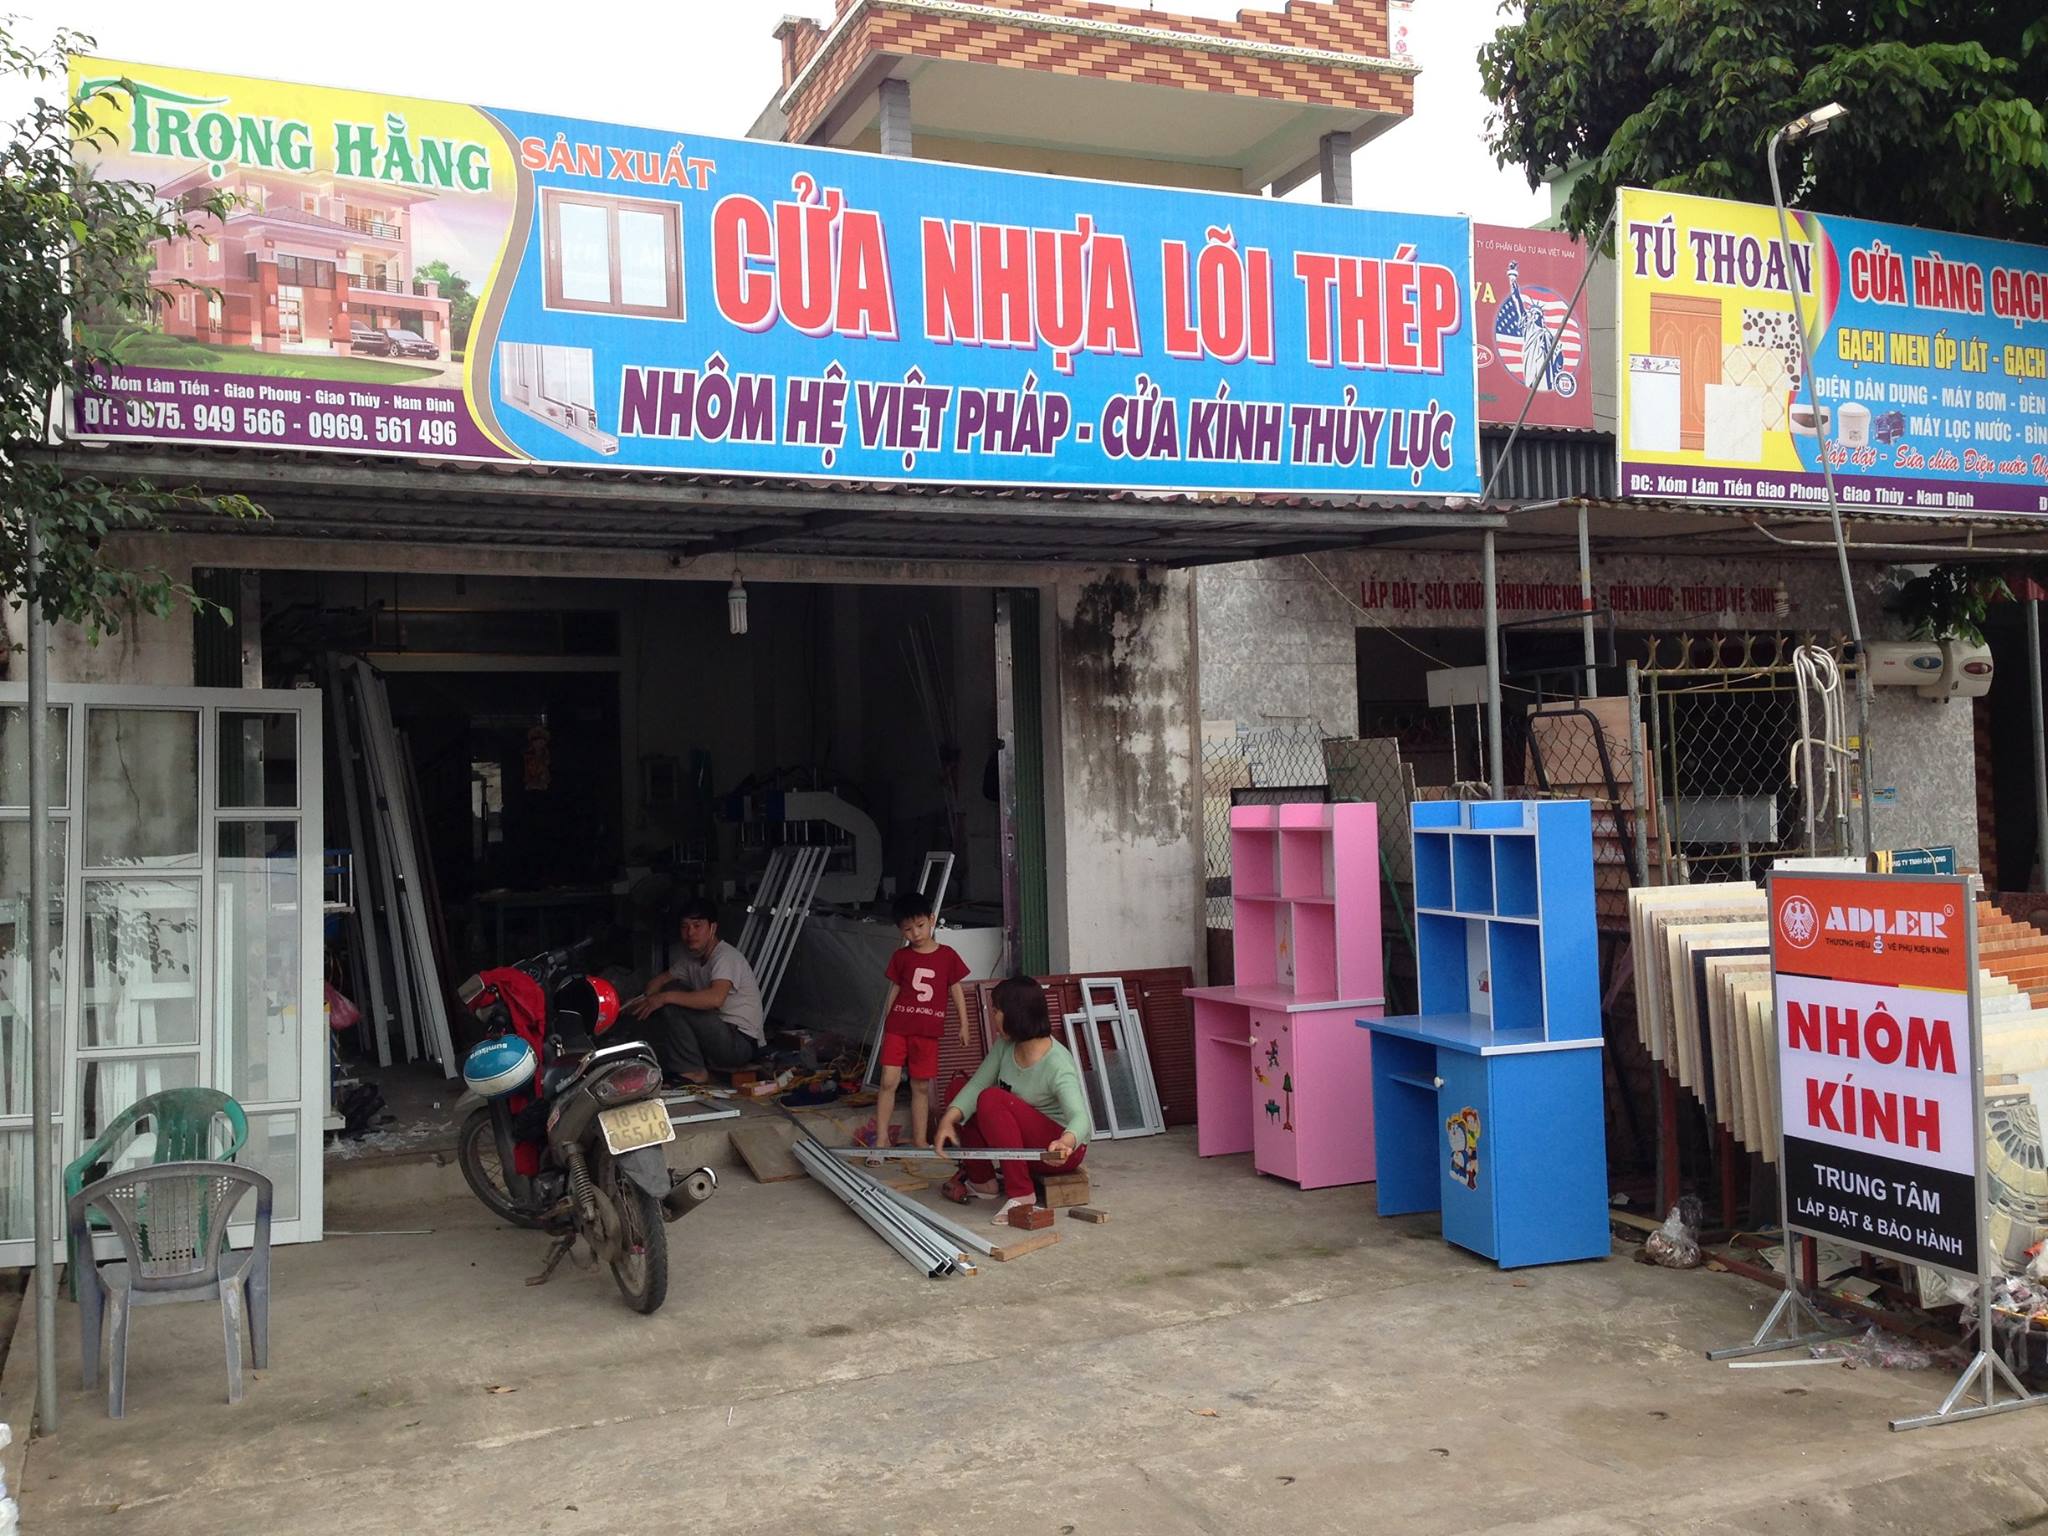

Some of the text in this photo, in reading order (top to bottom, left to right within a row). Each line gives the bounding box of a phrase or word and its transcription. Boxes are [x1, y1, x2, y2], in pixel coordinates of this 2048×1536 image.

[80, 79, 490, 191] TRỌNG HẰNG
[521, 133, 716, 190] SẢN XUẤT
[712, 172, 1461, 375] CỬA NHỰA LÕI THÉP
[1629, 214, 1812, 294] TÚ THOAN
[1850, 240, 1907, 305] CỬA
[1912, 250, 1984, 314] HÀNG
[1838, 327, 1885, 369] GẠCH
[1889, 332, 1930, 369] MEN
[1933, 328, 1957, 370] ỐP
[1960, 335, 1989, 374] LÁT
[2003, 344, 2047, 384] GẠCH
[112, 375, 141, 391] Xóm
[147, 377, 175, 394] Lâm
[179, 379, 210, 396] Tiến
[223, 383, 255, 399] Giao
[259, 385, 302, 404] Phong
[315, 389, 345, 406] Giao
[349, 391, 381, 409] Thủy
[393, 394, 422, 411] Nam
[425, 397, 456, 415] Định
[618, 351, 776, 445] NHÔM
[783, 359, 850, 469] HỆ
[856, 364, 953, 471] VIỆT
[953, 368, 1070, 457] PHÁP
[1101, 372, 1180, 461] CỬA
[1186, 378, 1285, 465] KÍNH
[1289, 383, 1384, 468] THỦY
[1387, 400, 1455, 486] LỰC
[1815, 376, 1851, 402] ĐIỆN
[1855, 380, 1886, 402] DÂN
[1889, 385, 1928, 407] DỤNG
[1942, 387, 1973, 409] MÁY
[1976, 390, 2007, 412] BƠM
[2019, 392, 2047, 415] ĐÈN
[193, 404, 236, 433] 949
[243, 407, 286, 436] 566
[308, 411, 369, 441] 0969.
[375, 416, 412, 444] 561
[418, 419, 457, 446] 496
[1909, 413, 1941, 438] MÁY
[1944, 418, 1971, 444] LỌC
[1974, 416, 2012, 442] NƯỚC
[1894, 443, 1925, 470] Sửa
[1964, 448, 1995, 479] Điện
[1630, 474, 1654, 491] ĐC:
[1657, 476, 1687, 493] Xóm
[1691, 477, 1719, 495] Lâm
[1723, 478, 1752, 496] Tiến
[1756, 482, 1786, 498] Giao
[1790, 483, 1829, 502] Phong
[1842, 486, 1871, 502] Giao
[1875, 487, 1904, 506] Thủy
[1916, 489, 1944, 506] Nam
[1947, 491, 1975, 509] Định
[1360, 570, 1389, 610] LẮP
[1392, 577, 1418, 613] ĐẶT
[1824, 906, 1947, 938] ADLER
[911, 967, 936, 1002] 5
[1786, 1000, 1957, 1075] NHÔM
[1806, 1073, 1941, 1153] KÍNH
[1813, 1163, 1941, 1215] TRUNG TÂM
[1863, 1214, 1874, 1233] &
[1877, 1217, 1912, 1241] BẢO
[1916, 1229, 1963, 1255] HÀNH
